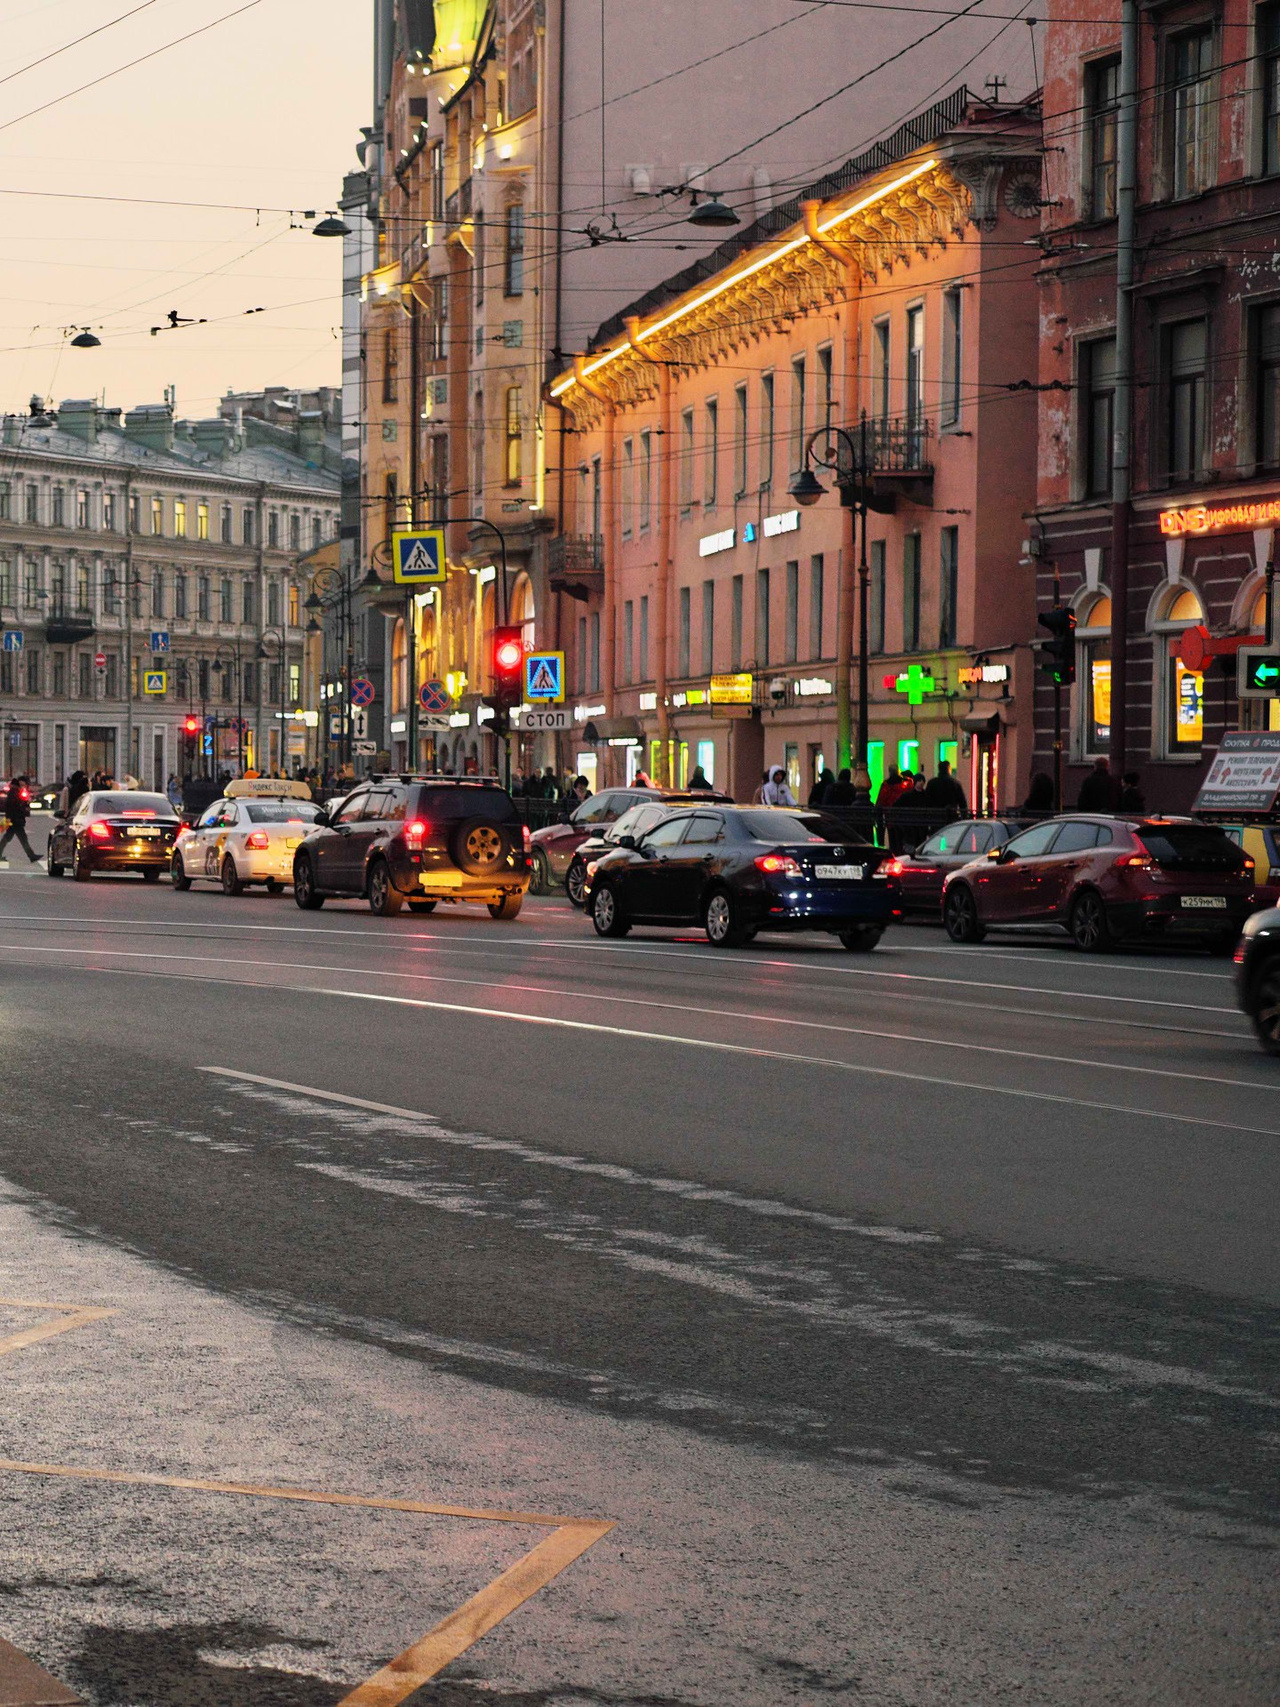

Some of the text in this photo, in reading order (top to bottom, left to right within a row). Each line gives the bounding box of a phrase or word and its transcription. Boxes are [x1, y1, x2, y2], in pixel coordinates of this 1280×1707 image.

[1160, 508, 1205, 534] DNS
[1204, 505, 1256, 527] ЦИФРОВАЯ
[526, 713, 565, 727] СТОП
[248, 781, 292, 791] Яндекс Такси
